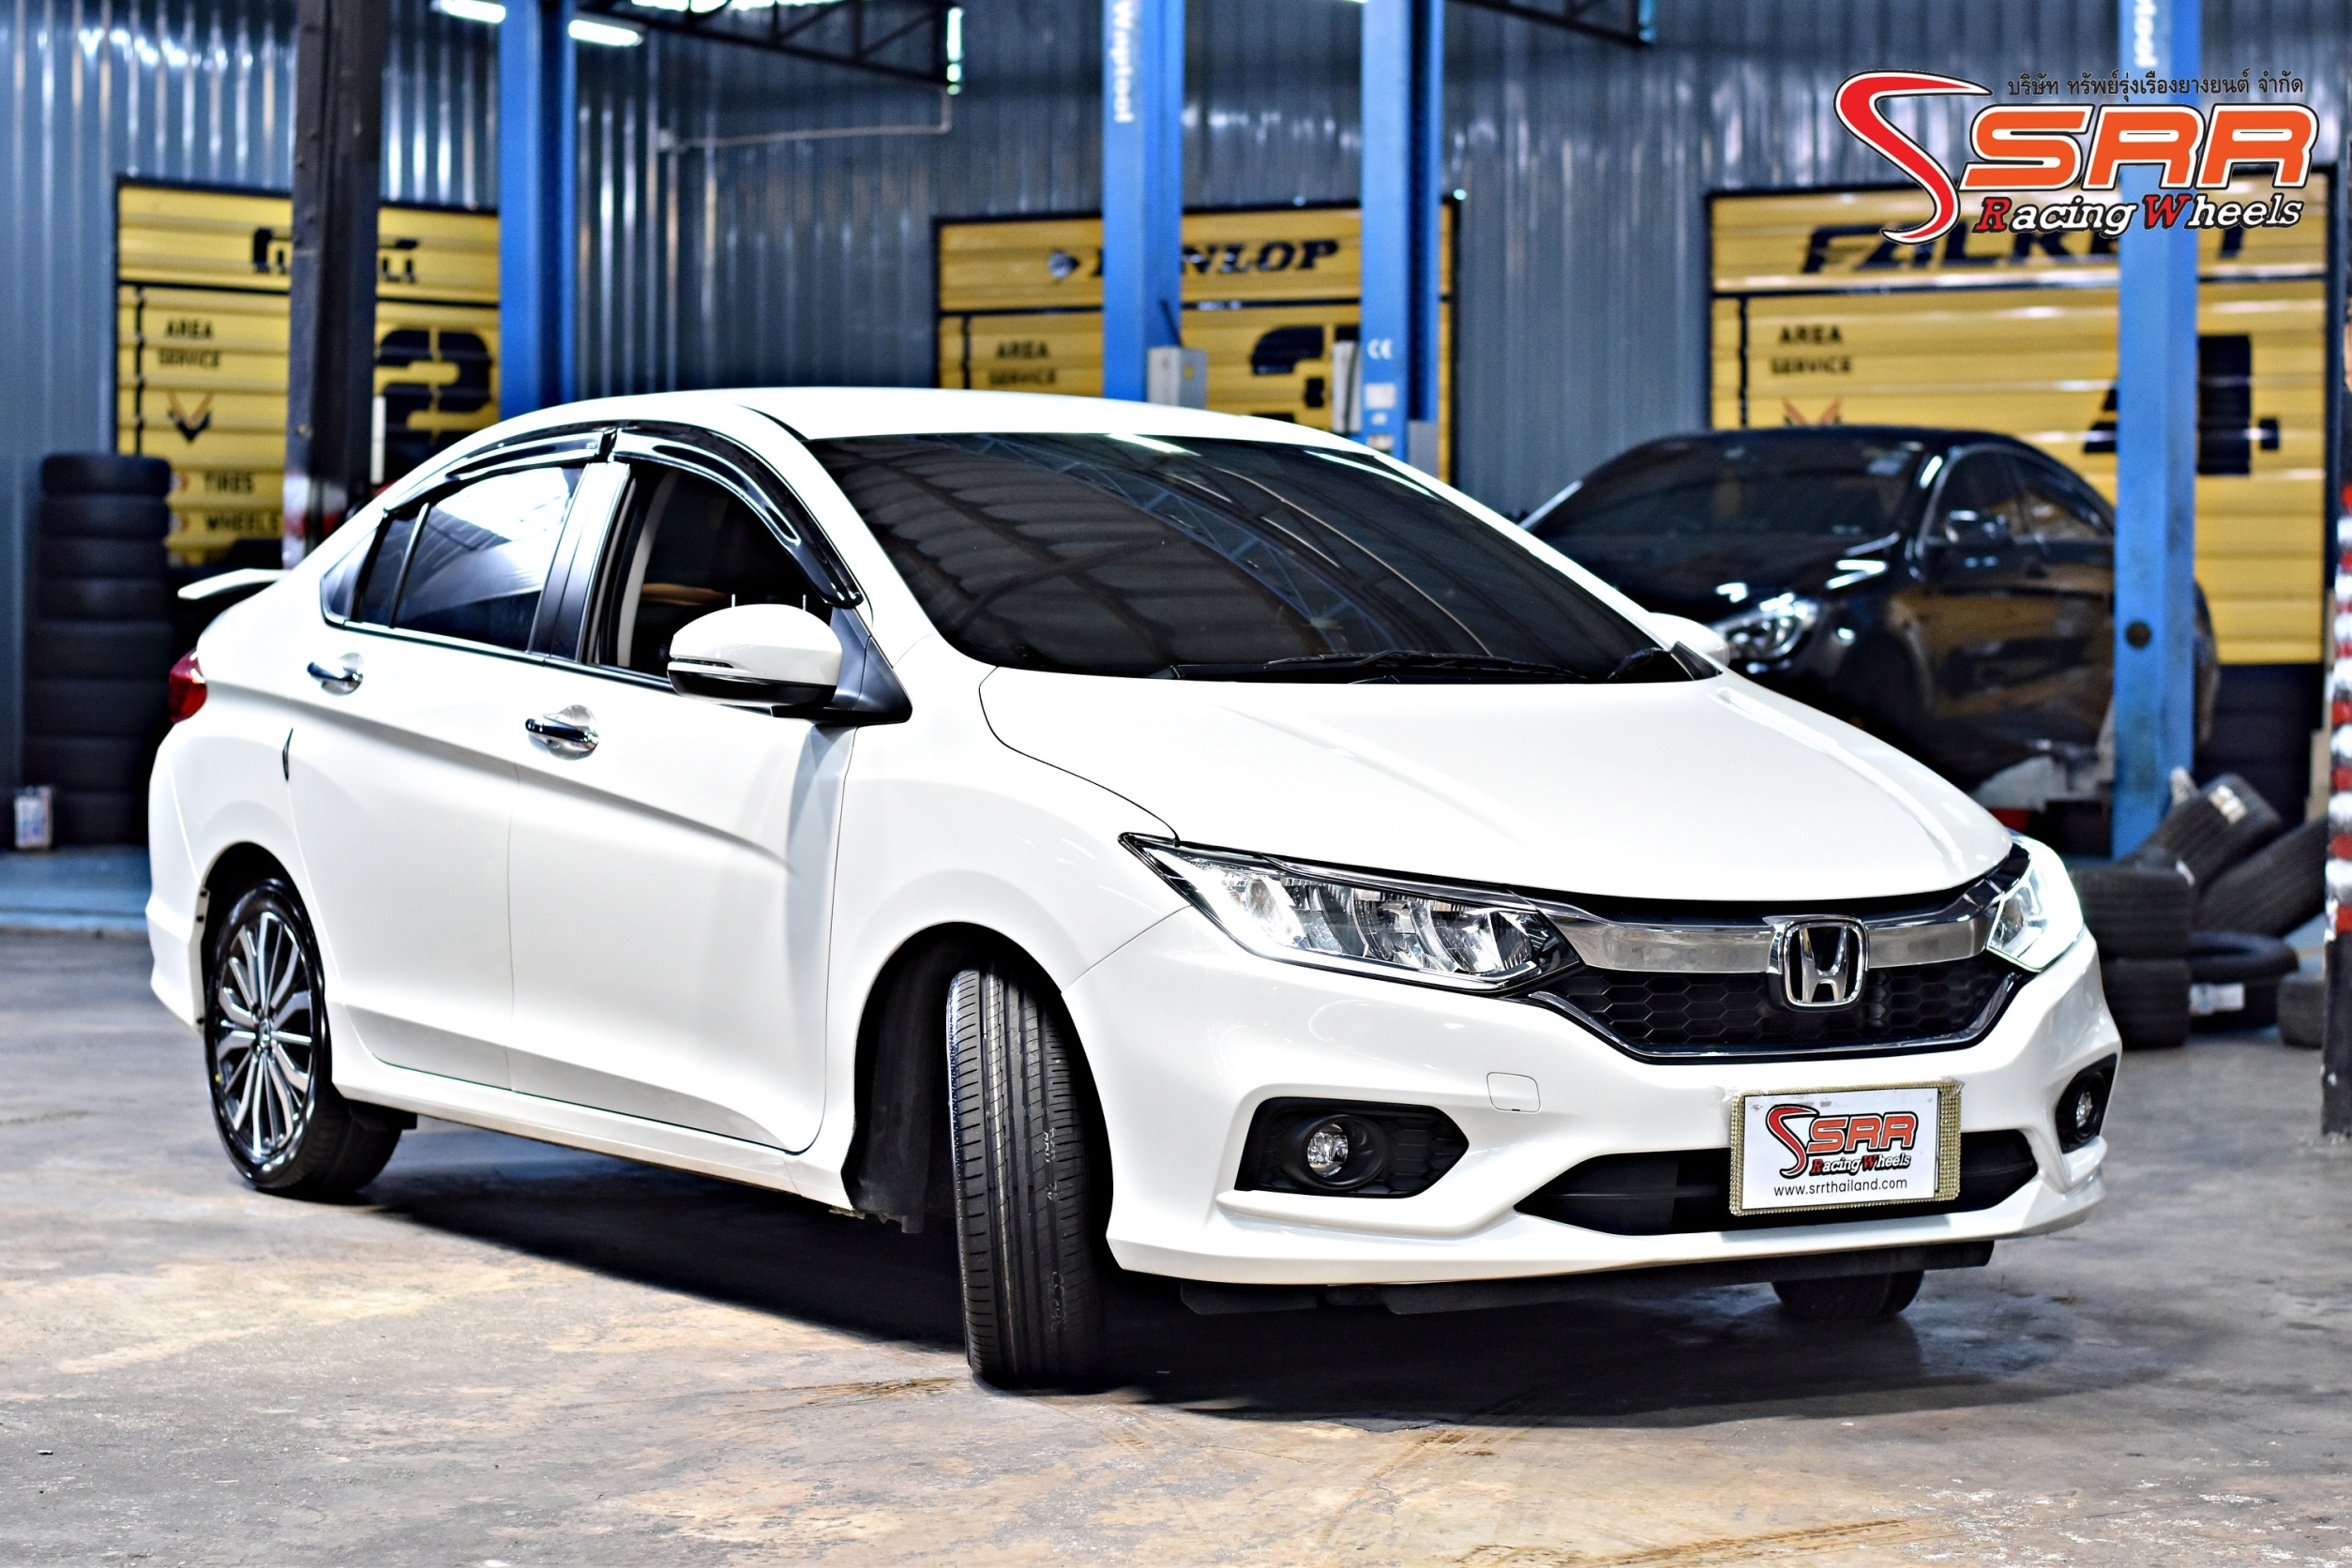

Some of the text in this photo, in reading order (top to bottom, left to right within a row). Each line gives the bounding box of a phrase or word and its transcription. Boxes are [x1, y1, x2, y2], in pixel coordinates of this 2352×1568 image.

[165, 319, 214, 339] AREA
[1778, 324, 1844, 345] AREA
[158, 348, 219, 369] SERVICE
[995, 339, 1050, 359] AREA
[1770, 355, 1853, 375] SERVICE
[204, 470, 254, 492] TIRES
[1806, 1110, 1919, 1156] SRR
[1809, 1153, 1911, 1177] Racing Wheels
[1773, 1178, 1907, 1197] www.srrthailand.com
